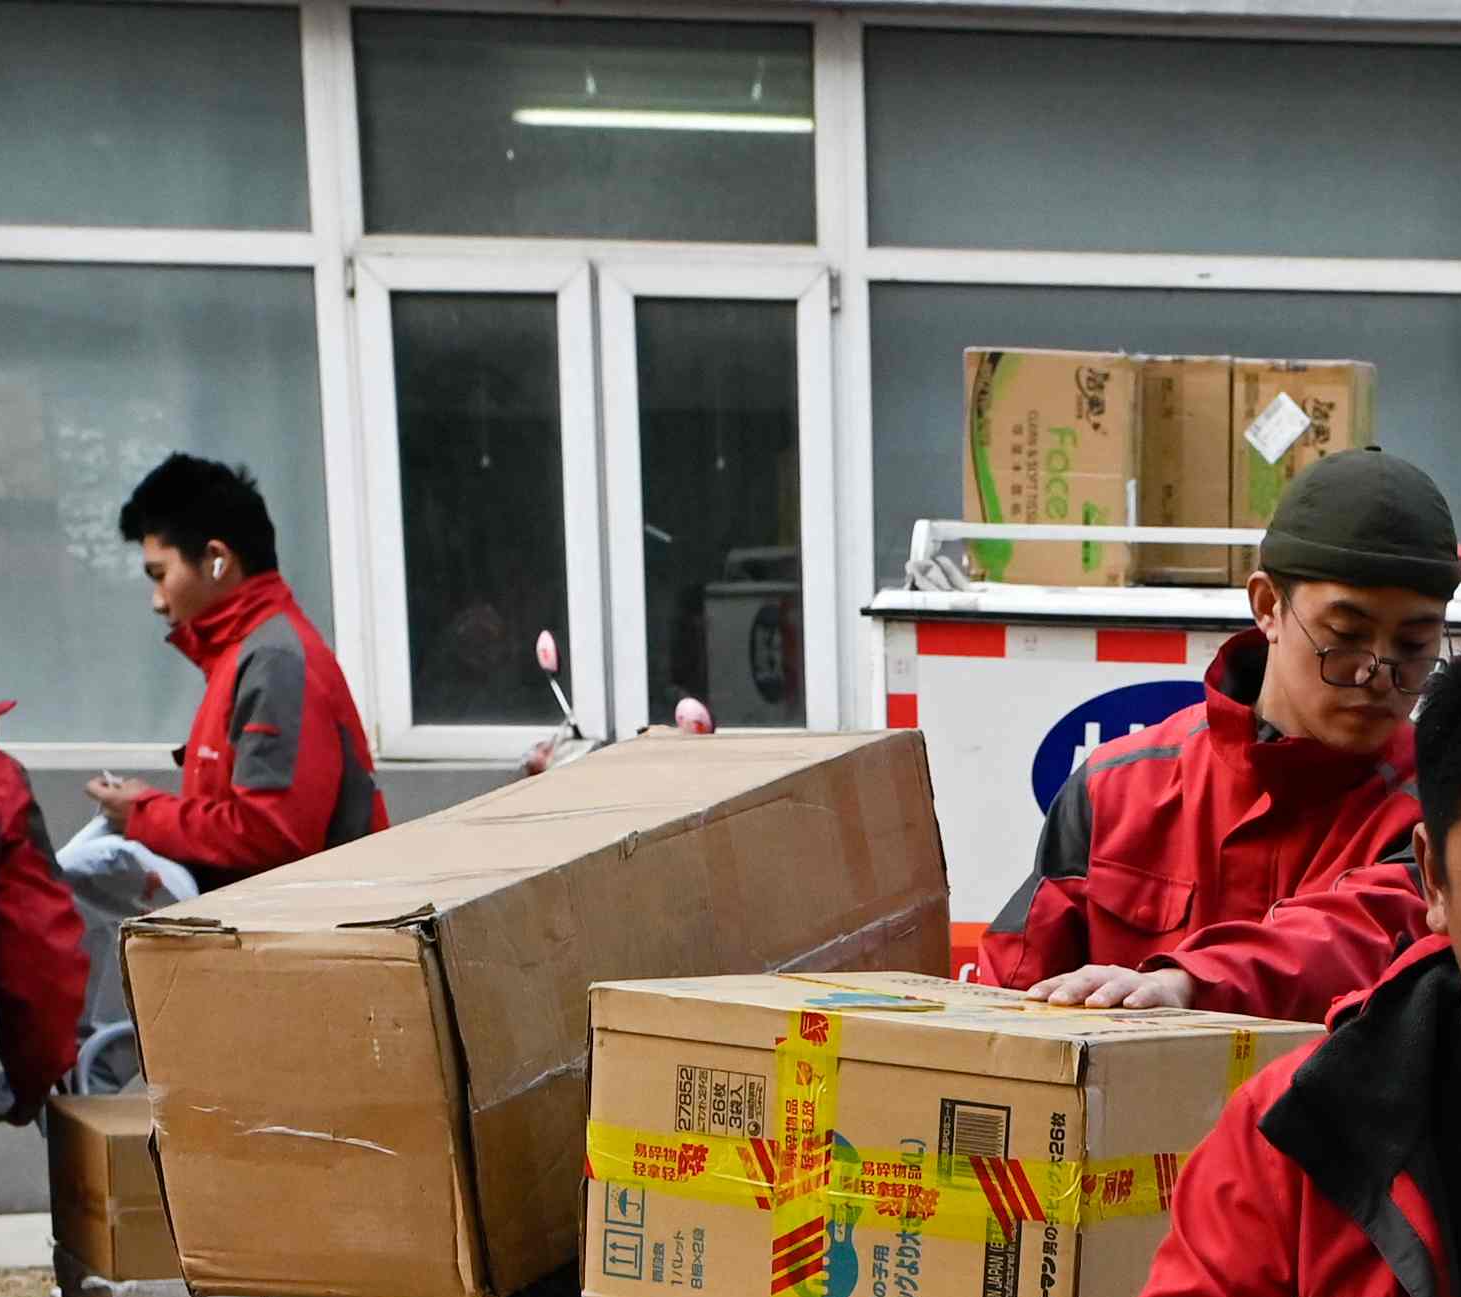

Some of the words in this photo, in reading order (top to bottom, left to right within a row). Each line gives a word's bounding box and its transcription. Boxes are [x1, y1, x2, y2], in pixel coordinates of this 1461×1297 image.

[1046, 427, 1078, 518] Face
[678, 1068, 693, 1131] 27852
[713, 1083, 725, 1125] 26枚
[730, 1086, 742, 1128] 3袋入
[634, 1142, 678, 1163] 易碎物
[862, 1161, 922, 1180] 易碎物品
[860, 1180, 923, 1199] 轻拿轻放
[987, 1255, 1004, 1288] JAPAN
